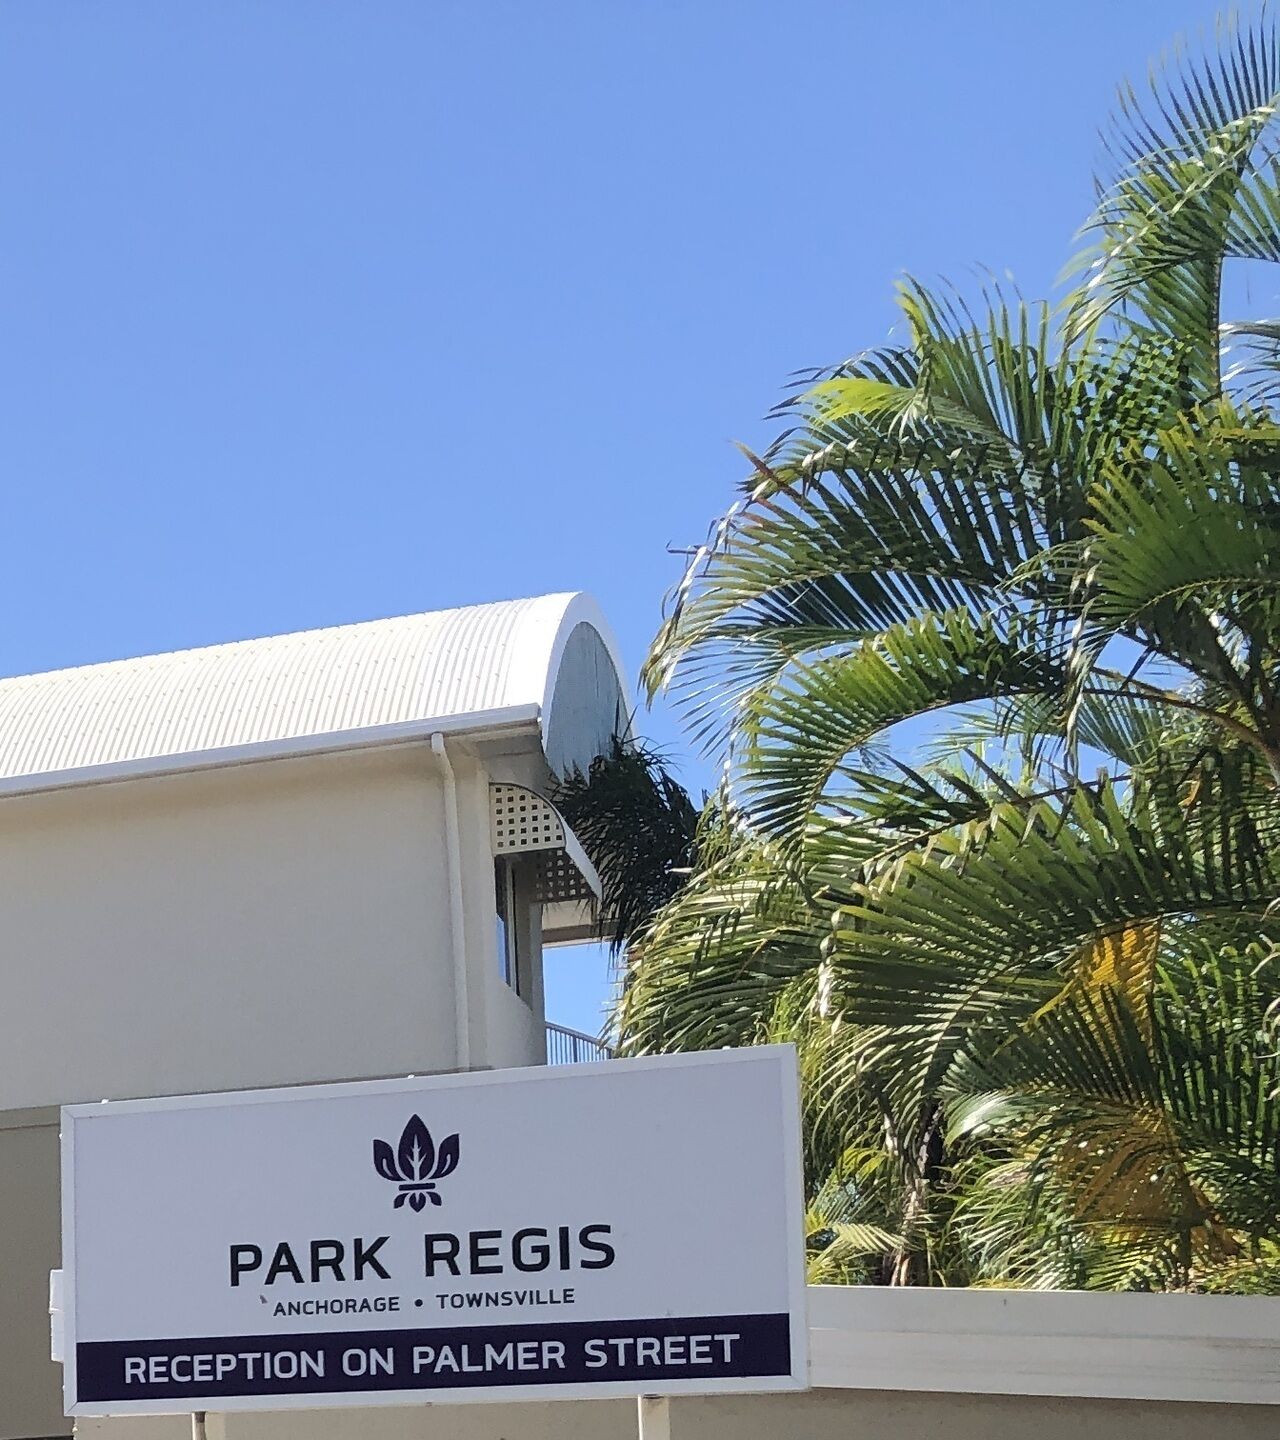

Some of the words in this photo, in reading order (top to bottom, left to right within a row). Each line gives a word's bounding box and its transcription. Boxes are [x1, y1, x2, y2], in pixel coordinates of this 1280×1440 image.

[229, 1235, 391, 1287] PARK
[424, 1224, 616, 1278] REGIS
[272, 1296, 401, 1317] ANCHORAGE
[435, 1288, 576, 1310] TOWNSVILLE
[124, 1350, 325, 1384] RECEPTION
[342, 1347, 394, 1377] ON
[412, 1340, 566, 1374] PALMER
[584, 1333, 741, 1368] STREET
